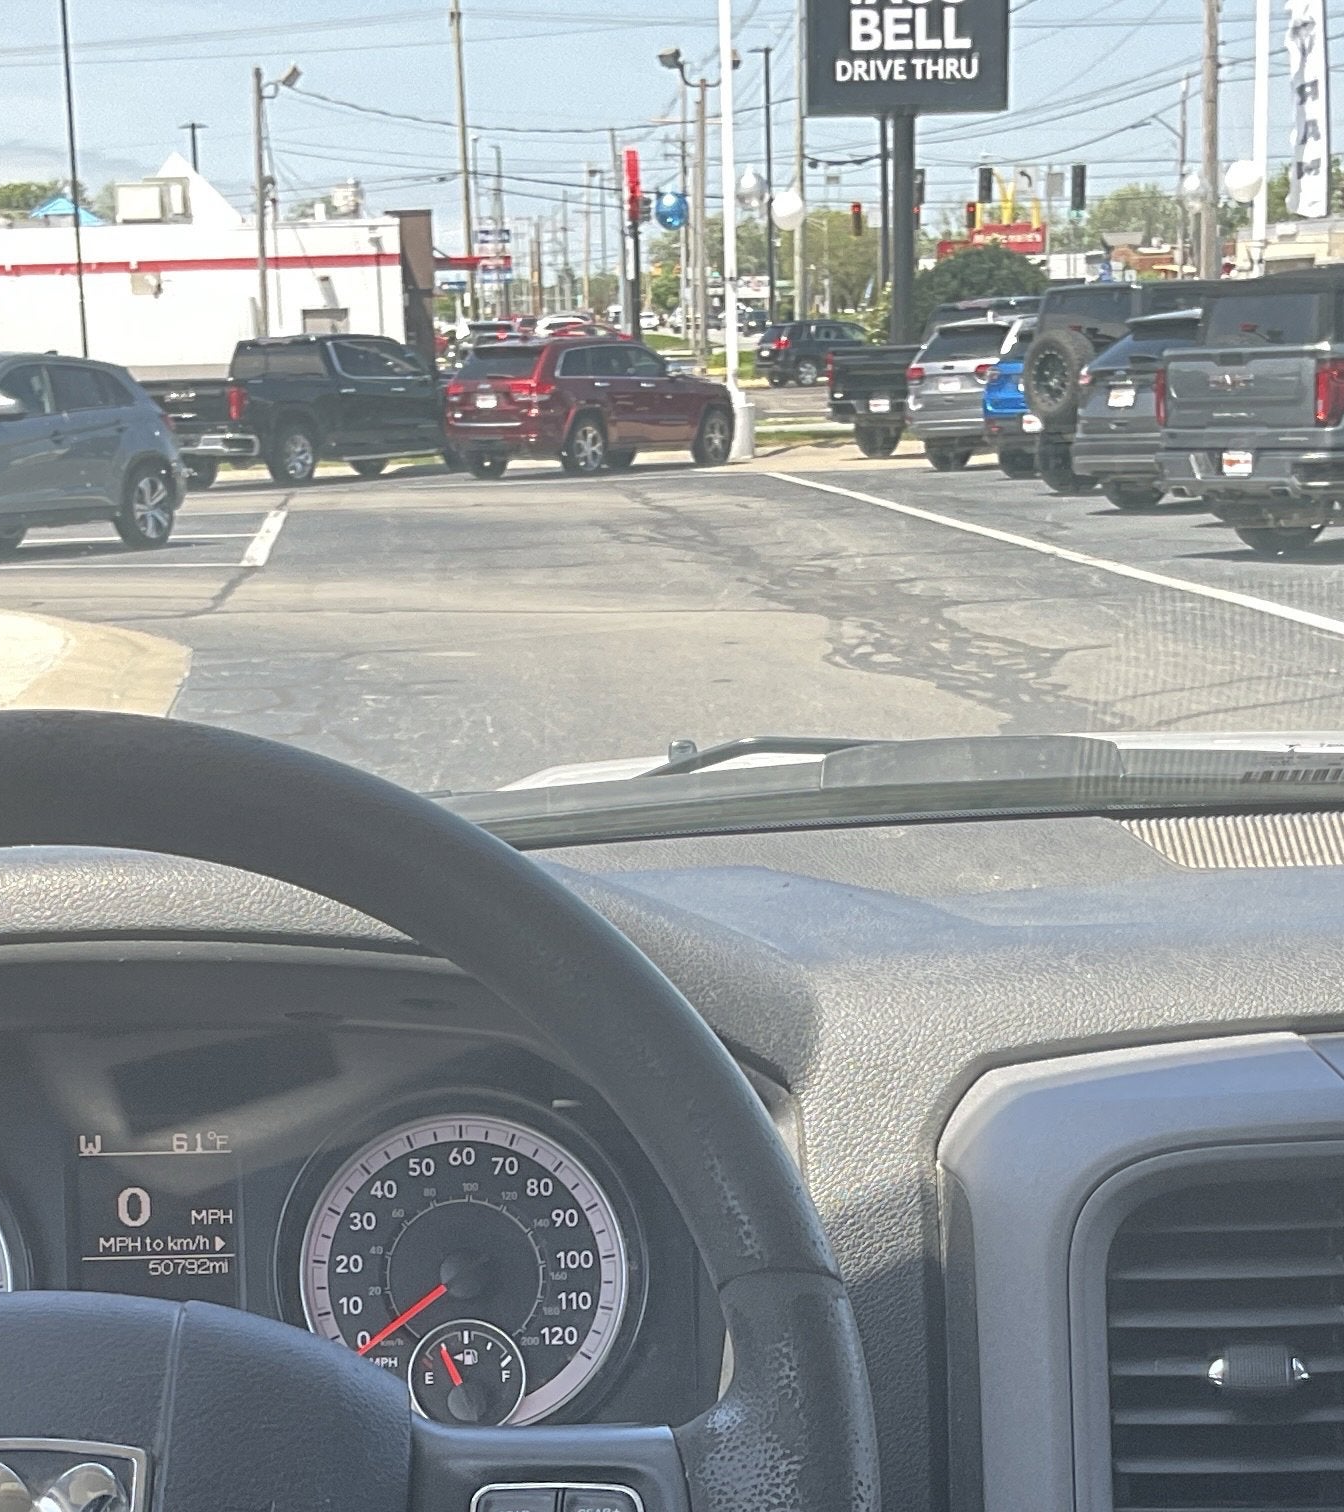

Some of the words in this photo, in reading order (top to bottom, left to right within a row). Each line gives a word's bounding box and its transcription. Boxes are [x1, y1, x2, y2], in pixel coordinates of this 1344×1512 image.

[850, 7, 972, 51] BELL
[835, 59, 906, 82] DRIVE
[911, 56, 979, 80] THRU
[79, 1134, 102, 1155] W
[449, 1147, 476, 1166] 60
[491, 1156, 519, 1176] 70
[408, 1157, 435, 1177] 50
[370, 1179, 397, 1199] 40
[423, 1187, 437, 1198] 80
[462, 1182, 479, 1193] 100
[501, 1191, 518, 1201] 120
[526, 1177, 553, 1197] 80
[117, 1186, 151, 1228] 0
[191, 1209, 233, 1225] MPH
[349, 1211, 376, 1231] 30
[551, 1208, 579, 1228] 90
[99, 1236, 141, 1252] MPH
[145, 1236, 164, 1251] to
[167, 1235, 210, 1251] km/h
[335, 1254, 363, 1274] 20
[555, 1250, 593, 1269] 100
[368, 1286, 382, 1296] 20
[557, 1291, 592, 1311] 110
[339, 1295, 363, 1315] 10
[540, 1326, 577, 1346] 120
[424, 1372, 434, 1386] E
[502, 1370, 511, 1383] F
